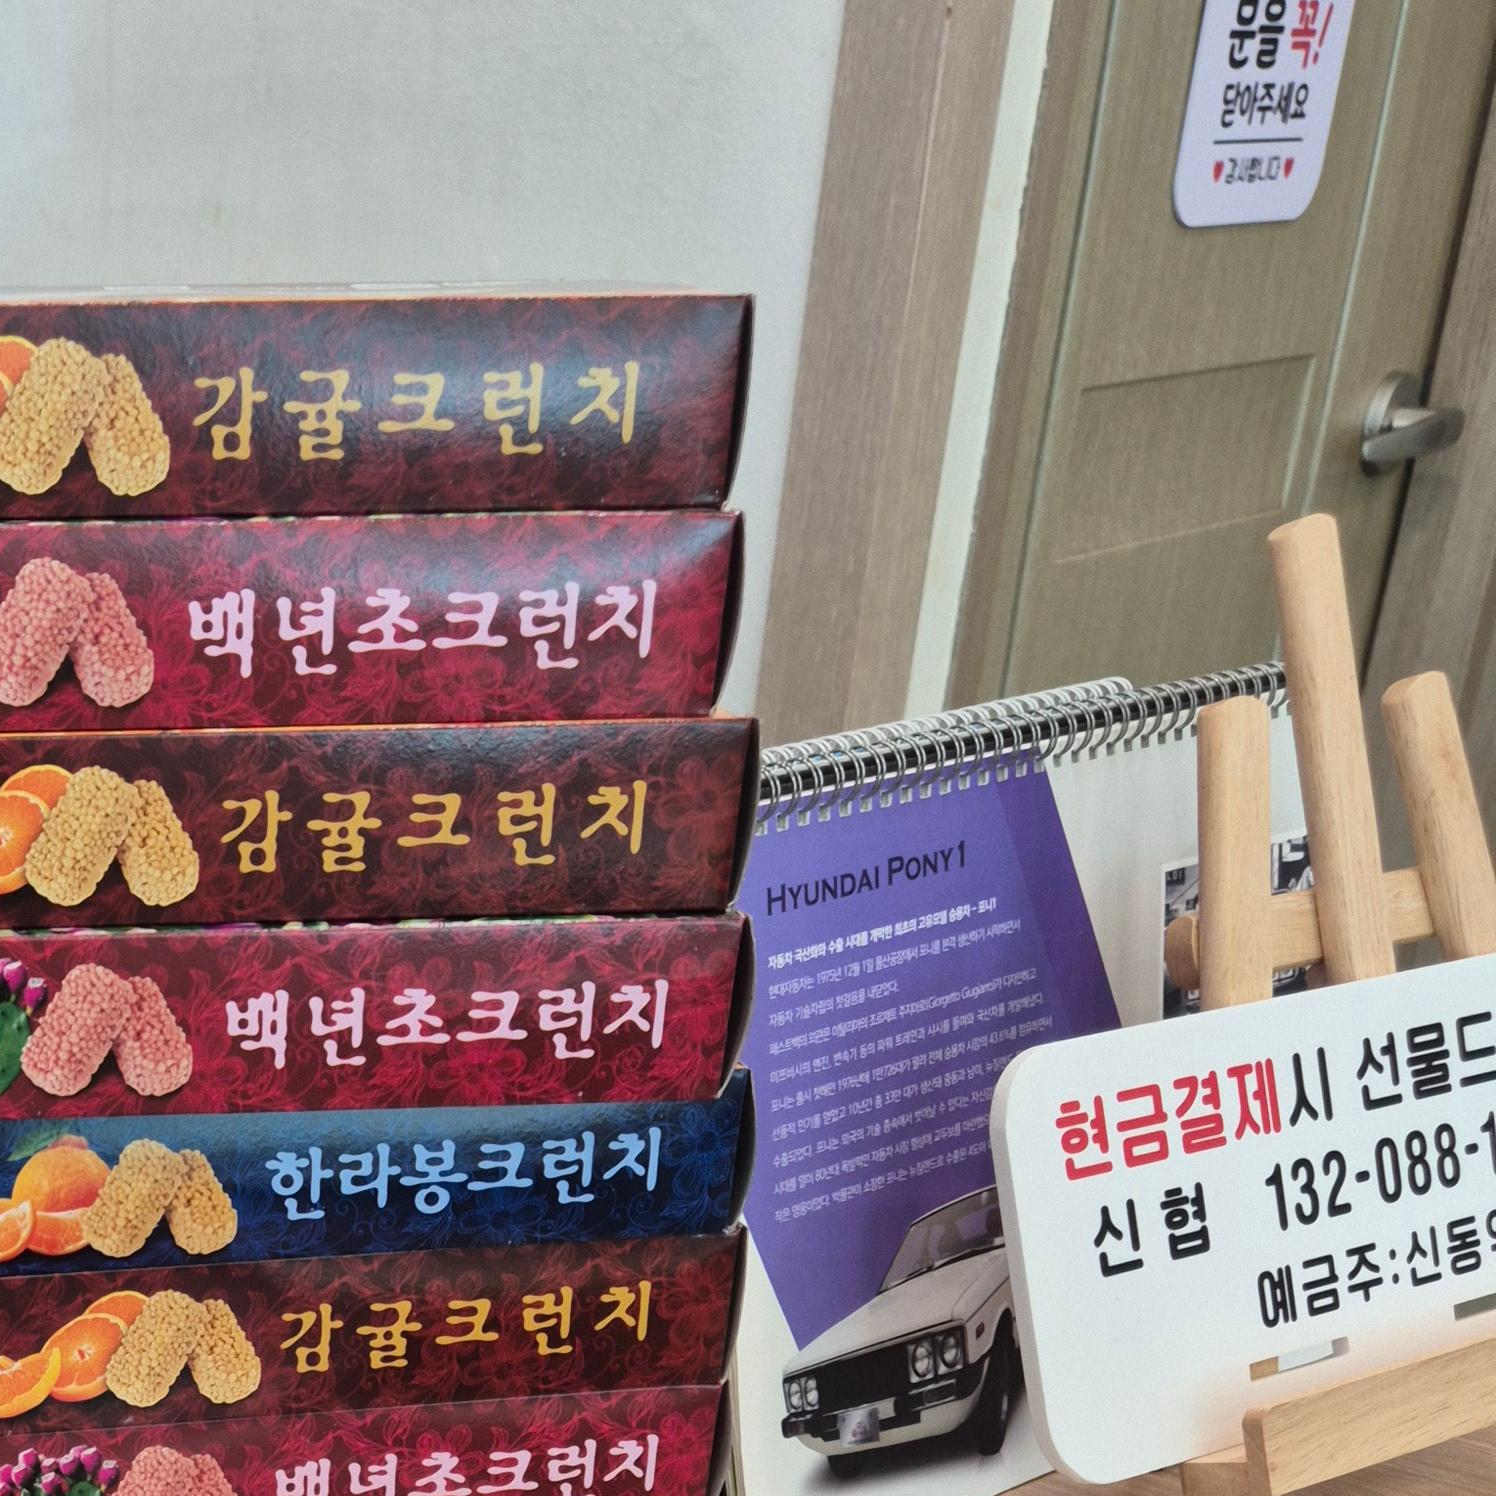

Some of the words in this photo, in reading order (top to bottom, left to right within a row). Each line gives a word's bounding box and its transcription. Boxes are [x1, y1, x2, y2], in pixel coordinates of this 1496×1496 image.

[1221, 81, 1310, 128] 닫아주세요
[192, 361, 641, 461] 감귤크런치
[188, 578, 659, 679] 백년초크런치
[221, 779, 649, 875] 감귤크런치
[766, 865, 881, 917] HYUNDAI
[768, 950, 792, 972] 자동차
[845, 929, 868, 950] 시대를
[895, 917, 916, 937] 최초의
[948, 903, 970, 923] 승용차
[768, 973, 814, 1000] 현대자동차는
[817, 966, 841, 987] 1975년
[844, 960, 859, 979] 12월
[862, 957, 873, 974] 1일
[919, 938, 940, 959] 포니를
[225, 979, 671, 1069] 백년초크런치
[768, 1007, 792, 1029] 자동차
[265, 1127, 662, 1221] 한라봉크런치
[280, 1280, 653, 1374] 감귤크런치
